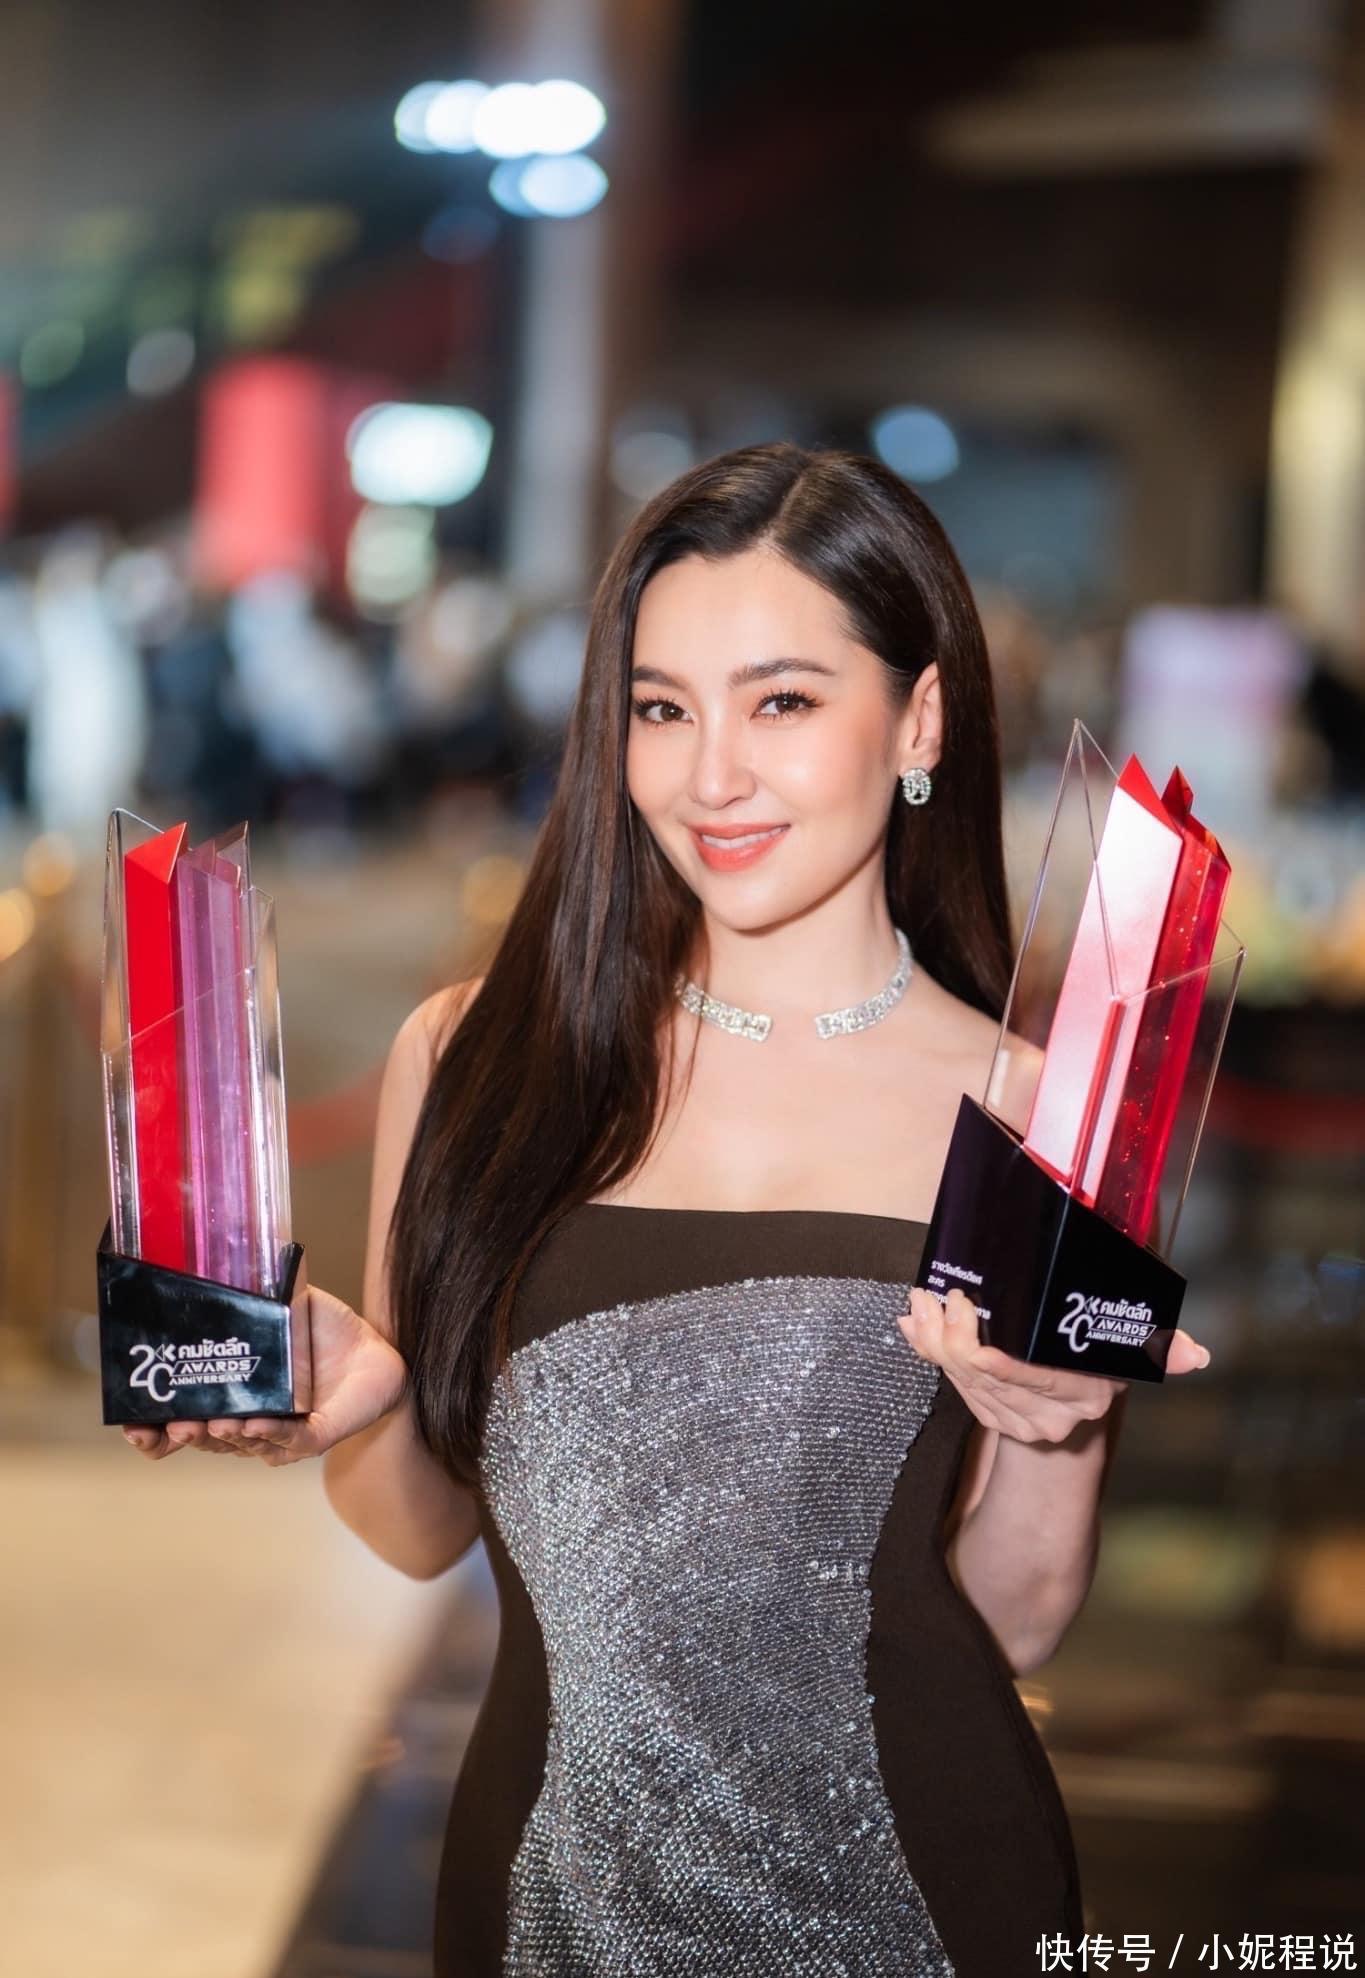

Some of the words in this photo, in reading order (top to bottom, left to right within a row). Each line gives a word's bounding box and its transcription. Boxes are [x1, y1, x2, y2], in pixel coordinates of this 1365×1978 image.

[1100, 1298, 1153, 1322] คมชัดลึก
[1096, 1318, 1149, 1337] AWARDS
[1085, 1331, 1146, 1347] ANNIVERSARY
[178, 1337, 250, 1359] คมชัดลึก
[181, 1359, 251, 1374] AWARDS
[169, 1373, 251, 1386] ANNIVERSARY
